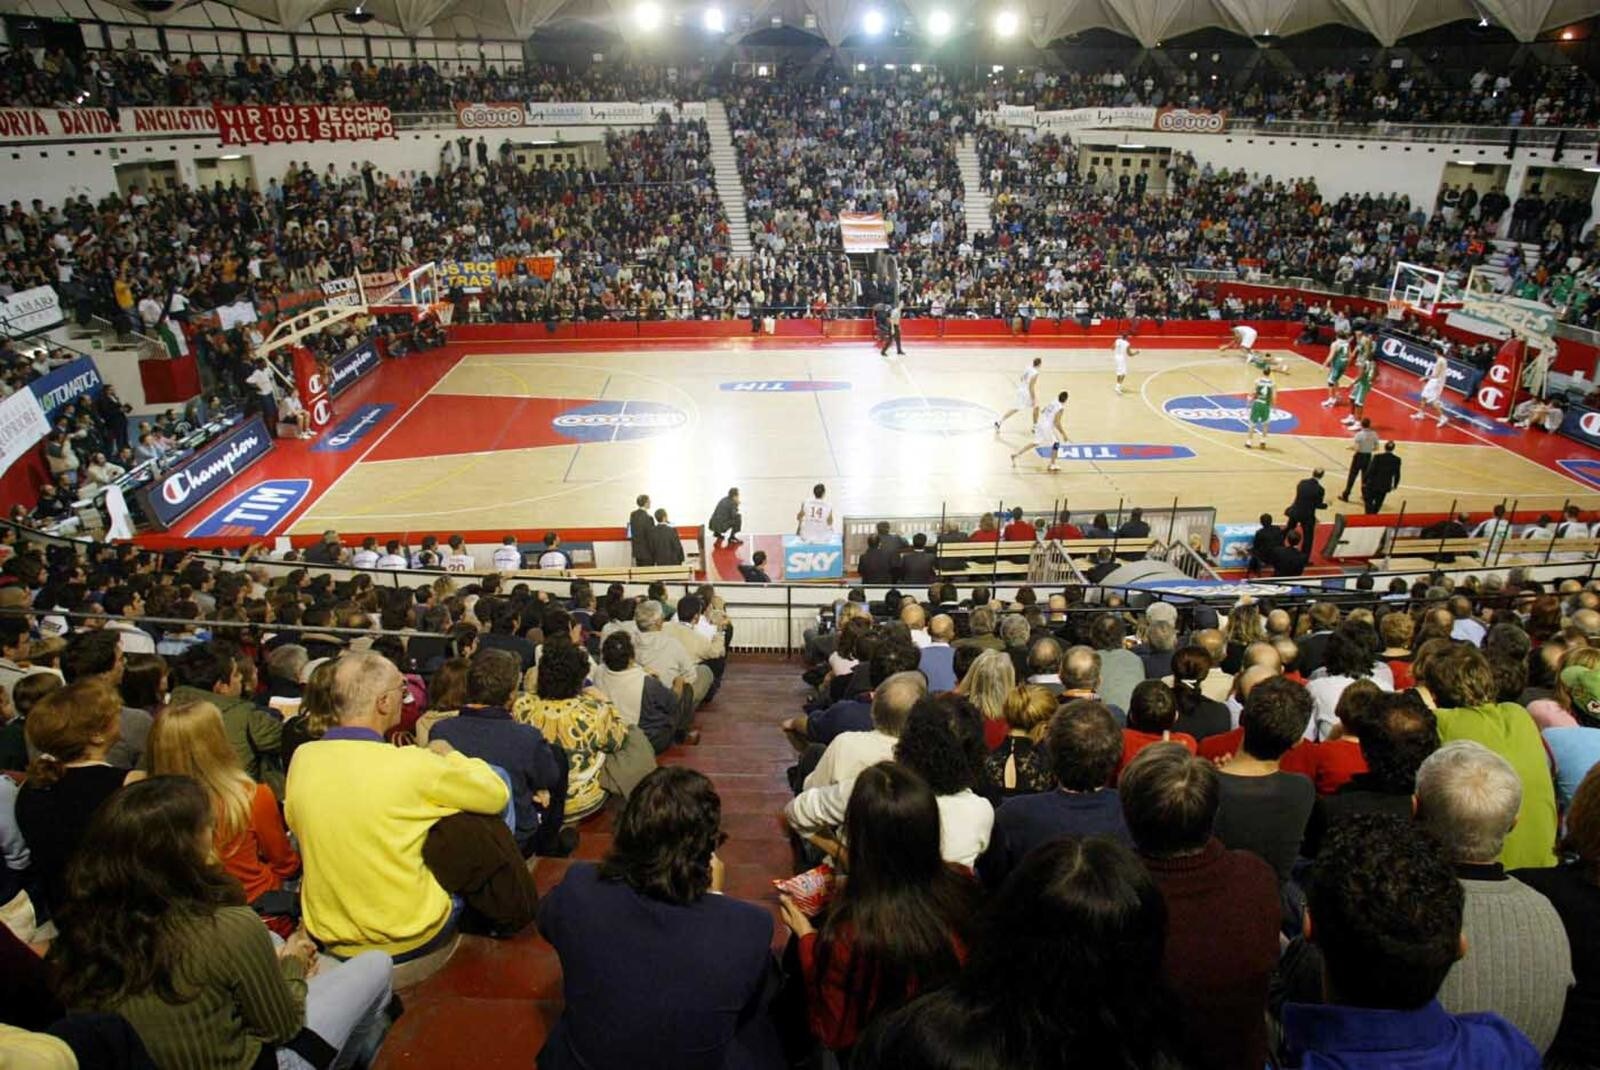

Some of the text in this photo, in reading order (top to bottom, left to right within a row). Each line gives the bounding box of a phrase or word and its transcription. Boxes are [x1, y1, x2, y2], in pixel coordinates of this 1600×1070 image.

[133, 109, 215, 131] ANCILOTTO
[221, 106, 391, 125] VIRTUS VECCHIO
[229, 121, 393, 142] ALCOOL STAMPO
[1382, 338, 1465, 380] Champon
[1057, 447, 1117, 458] TIM
[163, 435, 258, 504] Champion
[222, 487, 298, 523] TIM
[810, 506, 823, 518] 14
[786, 551, 840, 573] SKY
